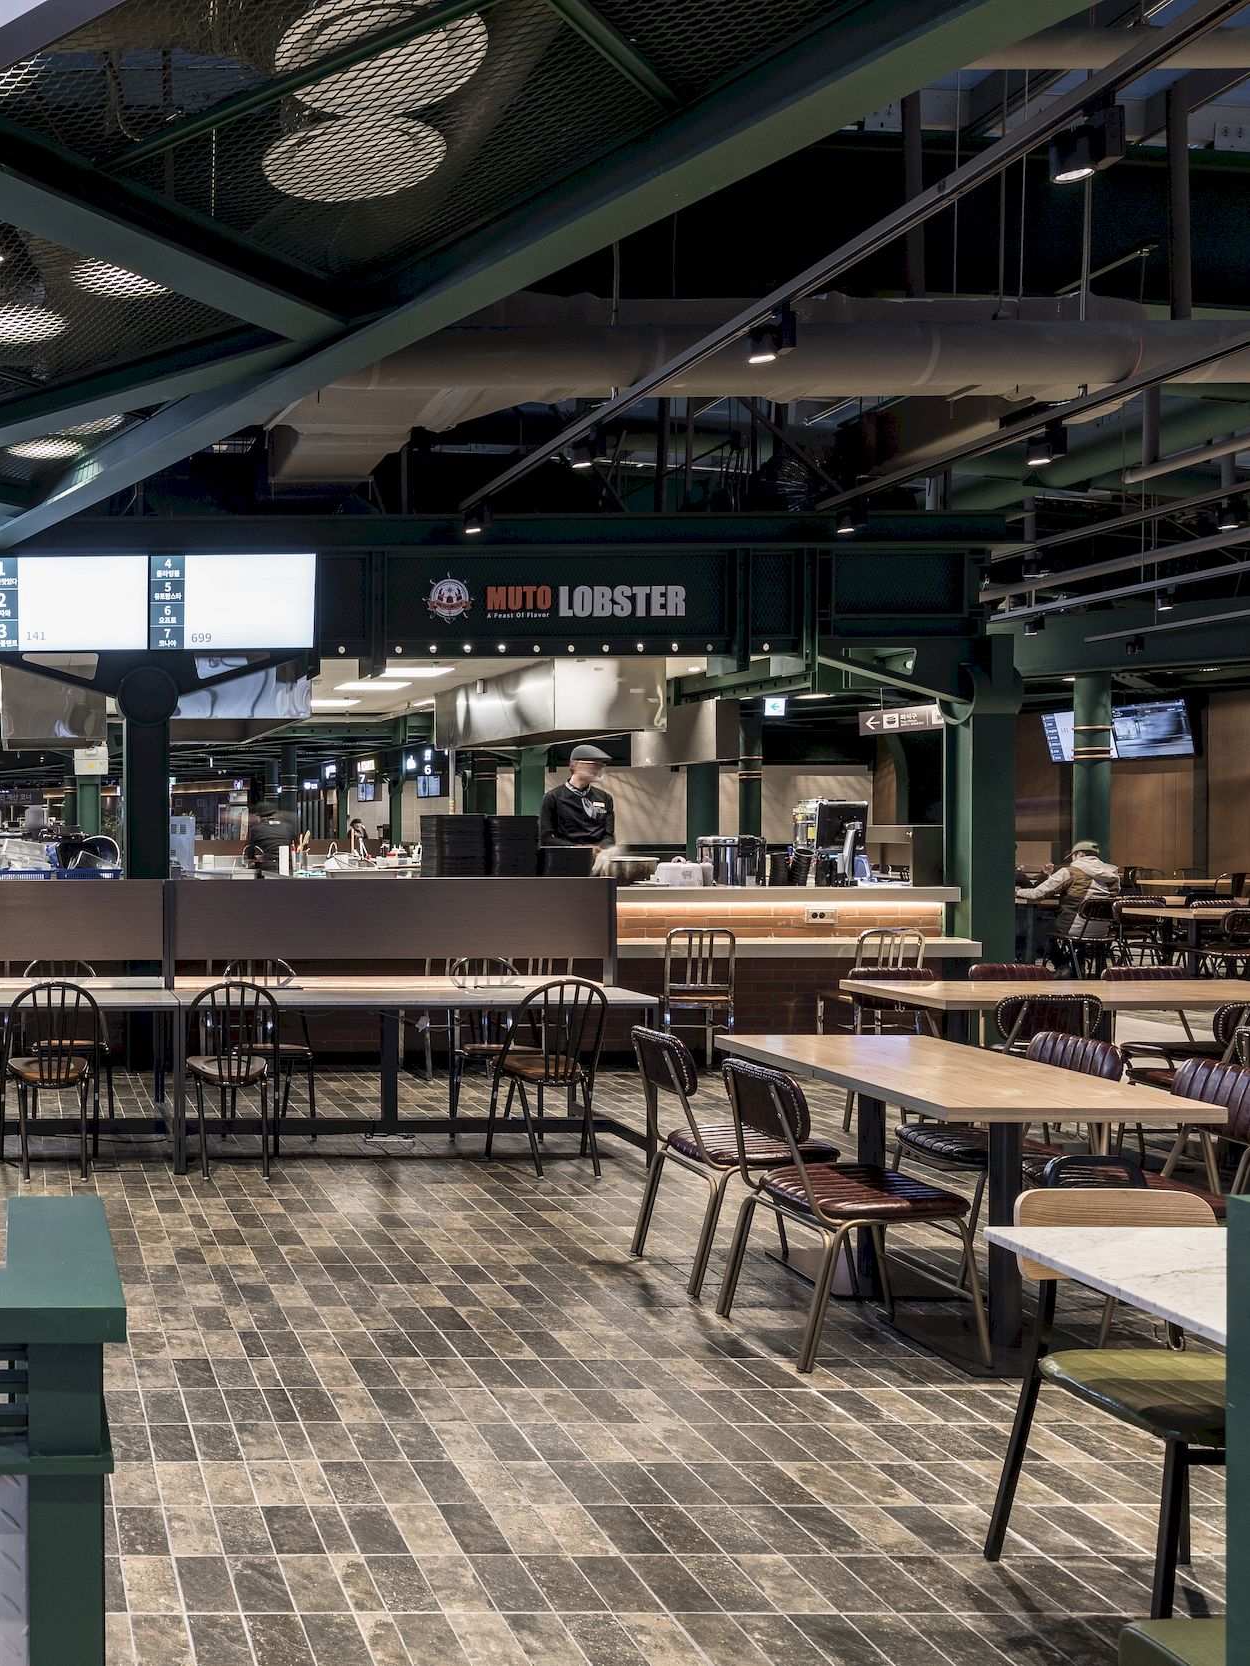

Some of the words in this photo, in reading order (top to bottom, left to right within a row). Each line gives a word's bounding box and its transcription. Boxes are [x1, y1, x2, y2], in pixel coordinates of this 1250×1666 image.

[164, 558, 172, 569] 4
[164, 582, 172, 593] 5
[486, 585, 551, 611] MUTO
[558, 585, 686, 618] LOBSTER
[164, 605, 172, 616] 6
[494, 611, 514, 619] Feast
[26, 631, 46, 641] 141
[164, 628, 171, 639] 7
[191, 632, 212, 643] 699
[424, 764, 432, 775] 6
[359, 775, 366, 783] 7
